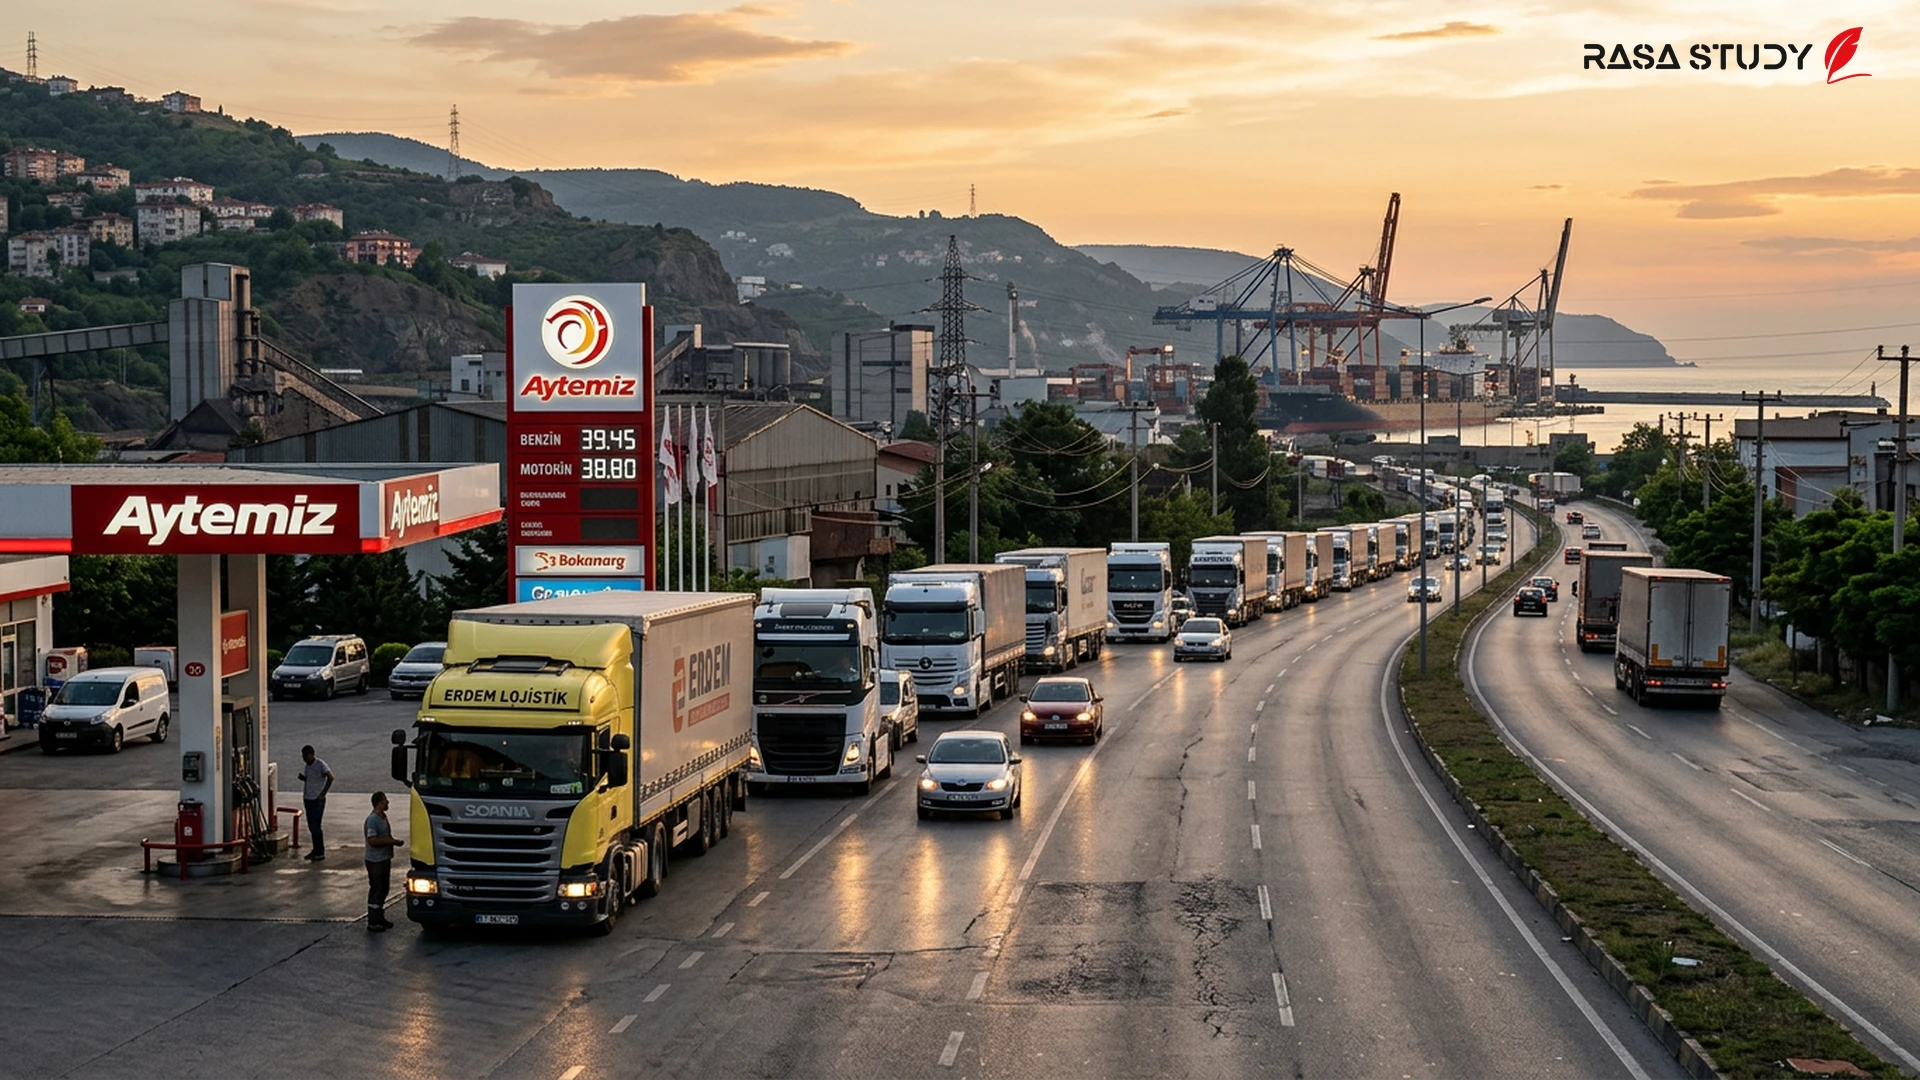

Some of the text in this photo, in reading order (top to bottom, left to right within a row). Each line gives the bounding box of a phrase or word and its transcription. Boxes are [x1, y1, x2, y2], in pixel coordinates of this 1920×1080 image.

[521, 375, 636, 401] Aytemiz
[520, 429, 636, 450] BENZİN 39.45
[581, 458, 636, 479] 38.80
[102, 494, 338, 546] Aytemiz
[559, 554, 626, 570] Bokanarg
[444, 687, 568, 705] ERDEM LOJİSTİK
